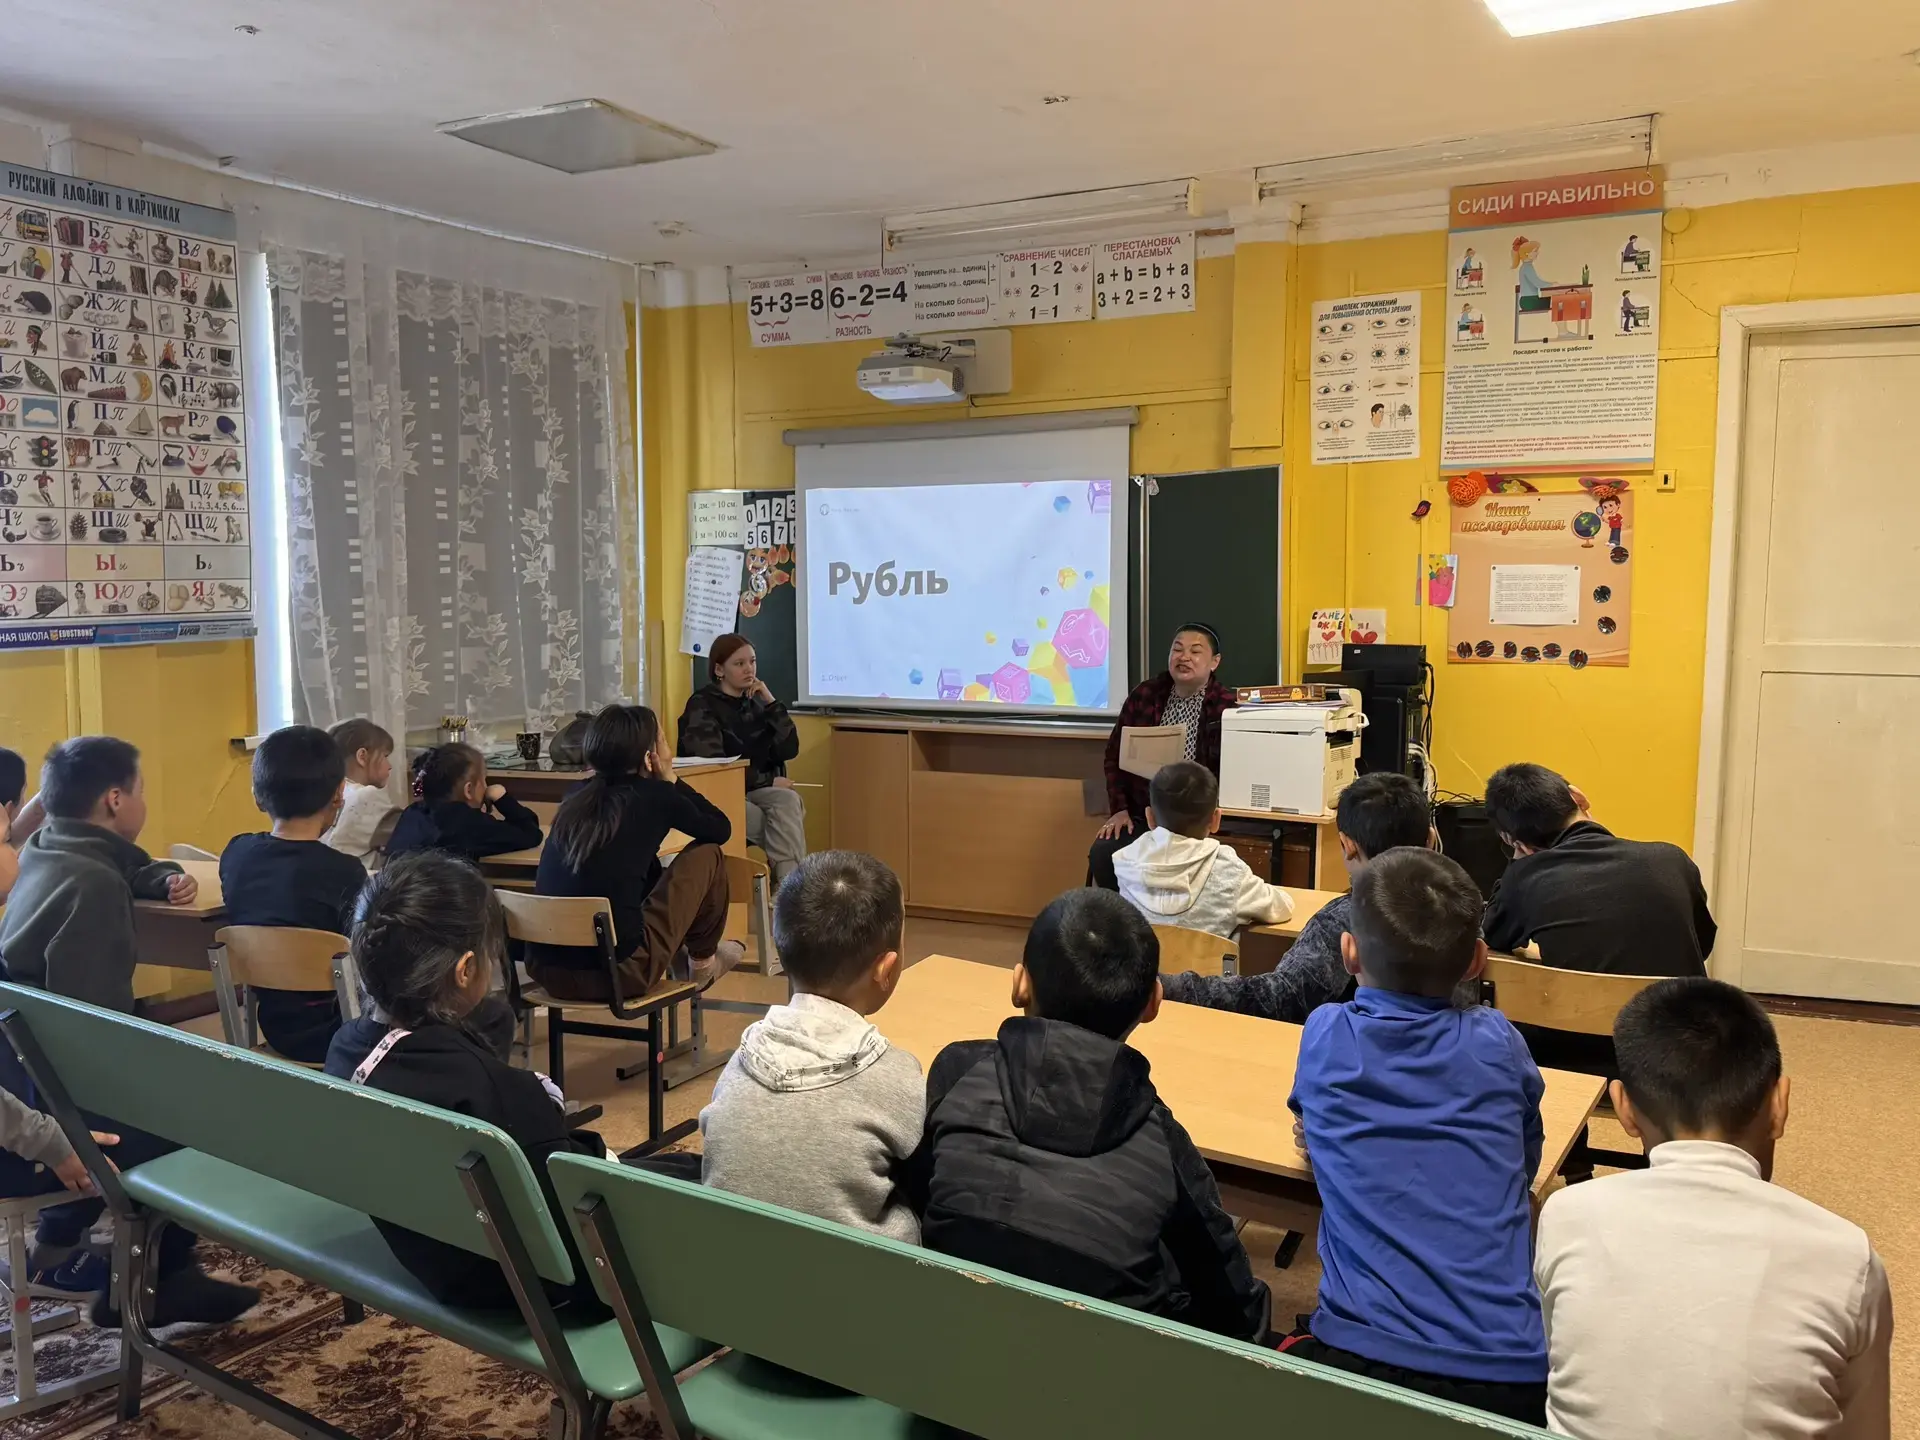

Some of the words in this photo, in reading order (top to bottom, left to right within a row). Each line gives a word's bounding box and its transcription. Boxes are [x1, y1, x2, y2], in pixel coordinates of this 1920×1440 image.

[9, 171, 56, 197] РУССКИЙ
[116, 196, 122, 211] В
[1458, 195, 1513, 215] СИДИ
[1521, 179, 1655, 209] ПРАВИЛЬНО
[1104, 236, 1181, 252] ПЕРЕСТАНОВКА
[1003, 250, 1056, 263] СРАВНЕНИЕ
[1059, 247, 1090, 258] ЧИСЕЛ
[1112, 246, 1172, 261] СЛАГАЕМЫХ
[1030, 262, 1037, 276] 1
[1053, 260, 1063, 274] 2
[1030, 284, 1040, 298] 2
[1053, 282, 1059, 296] 1
[750, 289, 824, 316] 5+3=8
[925, 299, 955, 308] сколько
[1030, 306, 1036, 320] 1
[1052, 305, 1058, 318] 1
[761, 332, 791, 343] СУММА
[835, 326, 872, 337] РАЗНОСТЬ
[746, 509, 753, 523] 0
[760, 504, 766, 518] 1
[775, 503, 782, 517] 2
[1485, 502, 1531, 517] Наши
[1461, 516, 1566, 536] исследования
[747, 531, 754, 545] 5
[761, 530, 768, 544] 6
[777, 526, 784, 540] 7
[828, 560, 949, 605] Рубль
[18, 631, 50, 642] ШКОЛА
